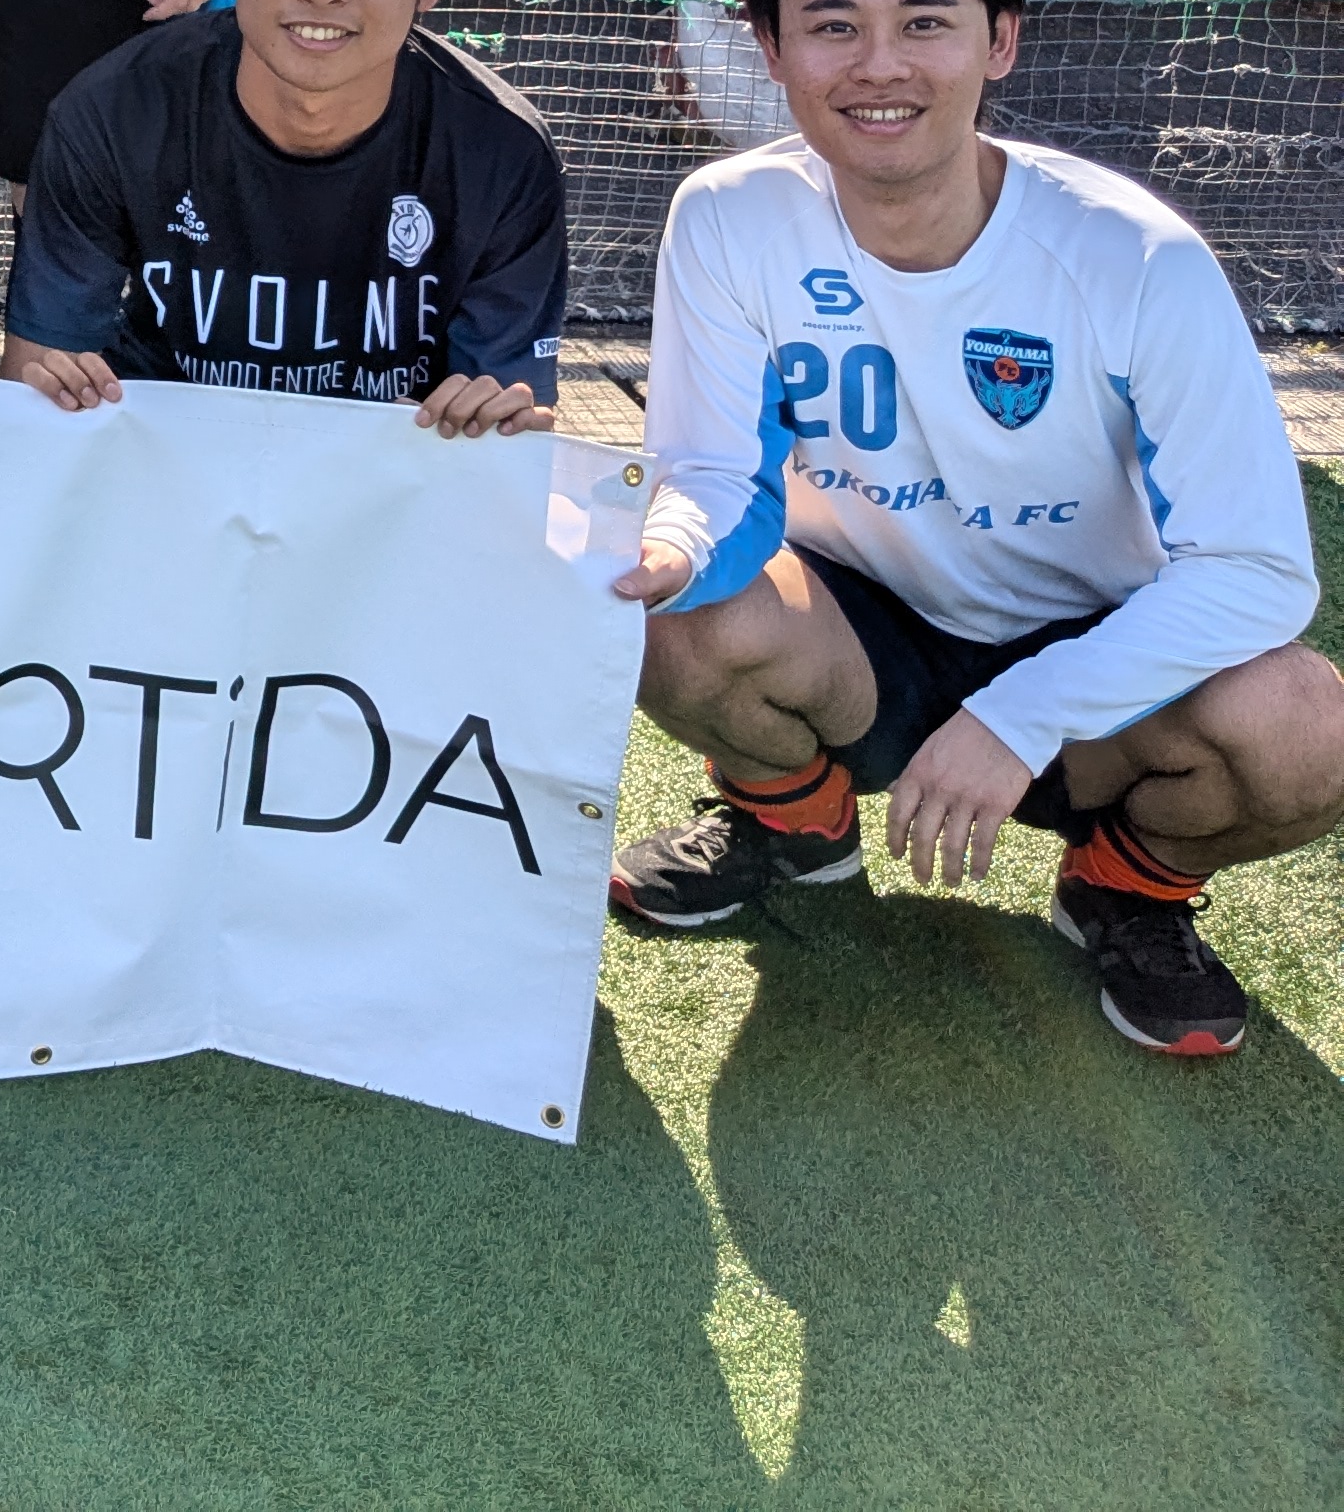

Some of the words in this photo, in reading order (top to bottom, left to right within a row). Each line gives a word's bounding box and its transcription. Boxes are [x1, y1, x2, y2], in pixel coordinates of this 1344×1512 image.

[964, 337, 1050, 362] YOKOHAMA
[270, 360, 345, 394] ENTRE
[776, 341, 899, 452] 20
[1011, 500, 1080, 527] FC
